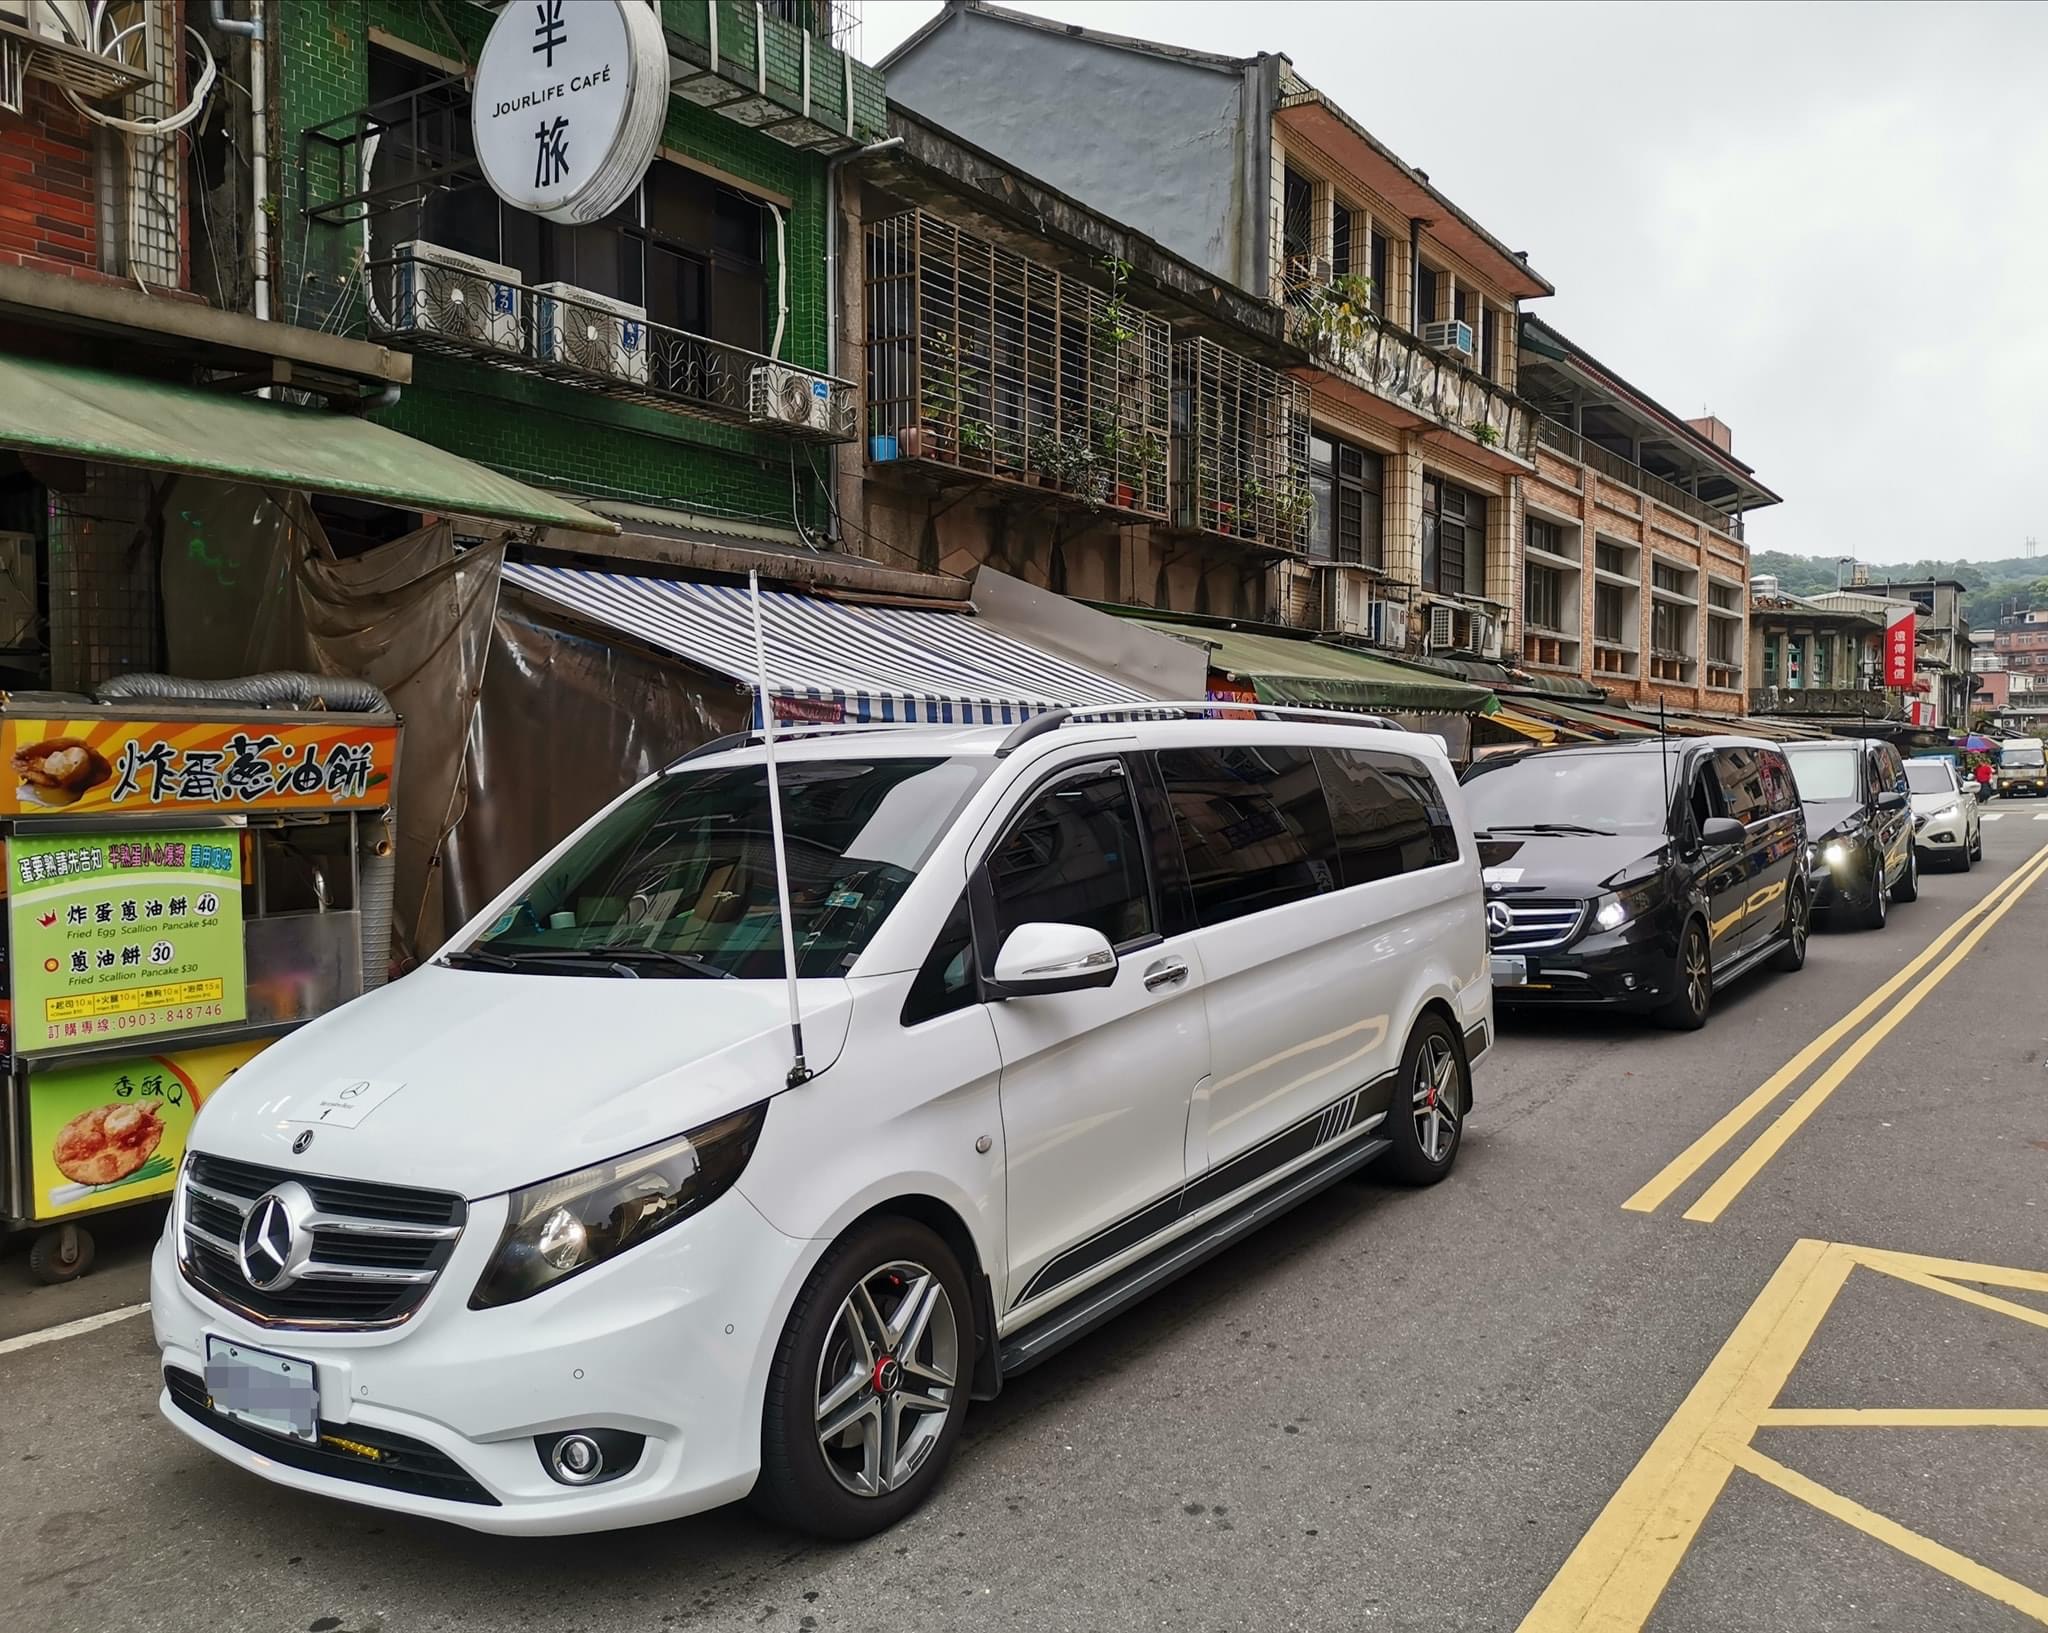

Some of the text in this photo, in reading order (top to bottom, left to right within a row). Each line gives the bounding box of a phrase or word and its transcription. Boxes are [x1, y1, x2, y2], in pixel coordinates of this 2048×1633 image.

[533, 0, 567, 68] 半
[534, 115, 570, 189] 旅
[112, 734, 374, 803] 炸蛋蔥油餅
[18, 846, 104, 884] 蛋要熟請先告知
[67, 897, 216, 924] 炸蛋蔥油餅 40
[67, 918, 218, 940] Fried Egg Scallion Pancake $40
[68, 964, 198, 986] Fried Scallion Pancake $30
[71, 945, 171, 973] 蔥油餅 30
[112, 1075, 183, 1107] 香酥Q
